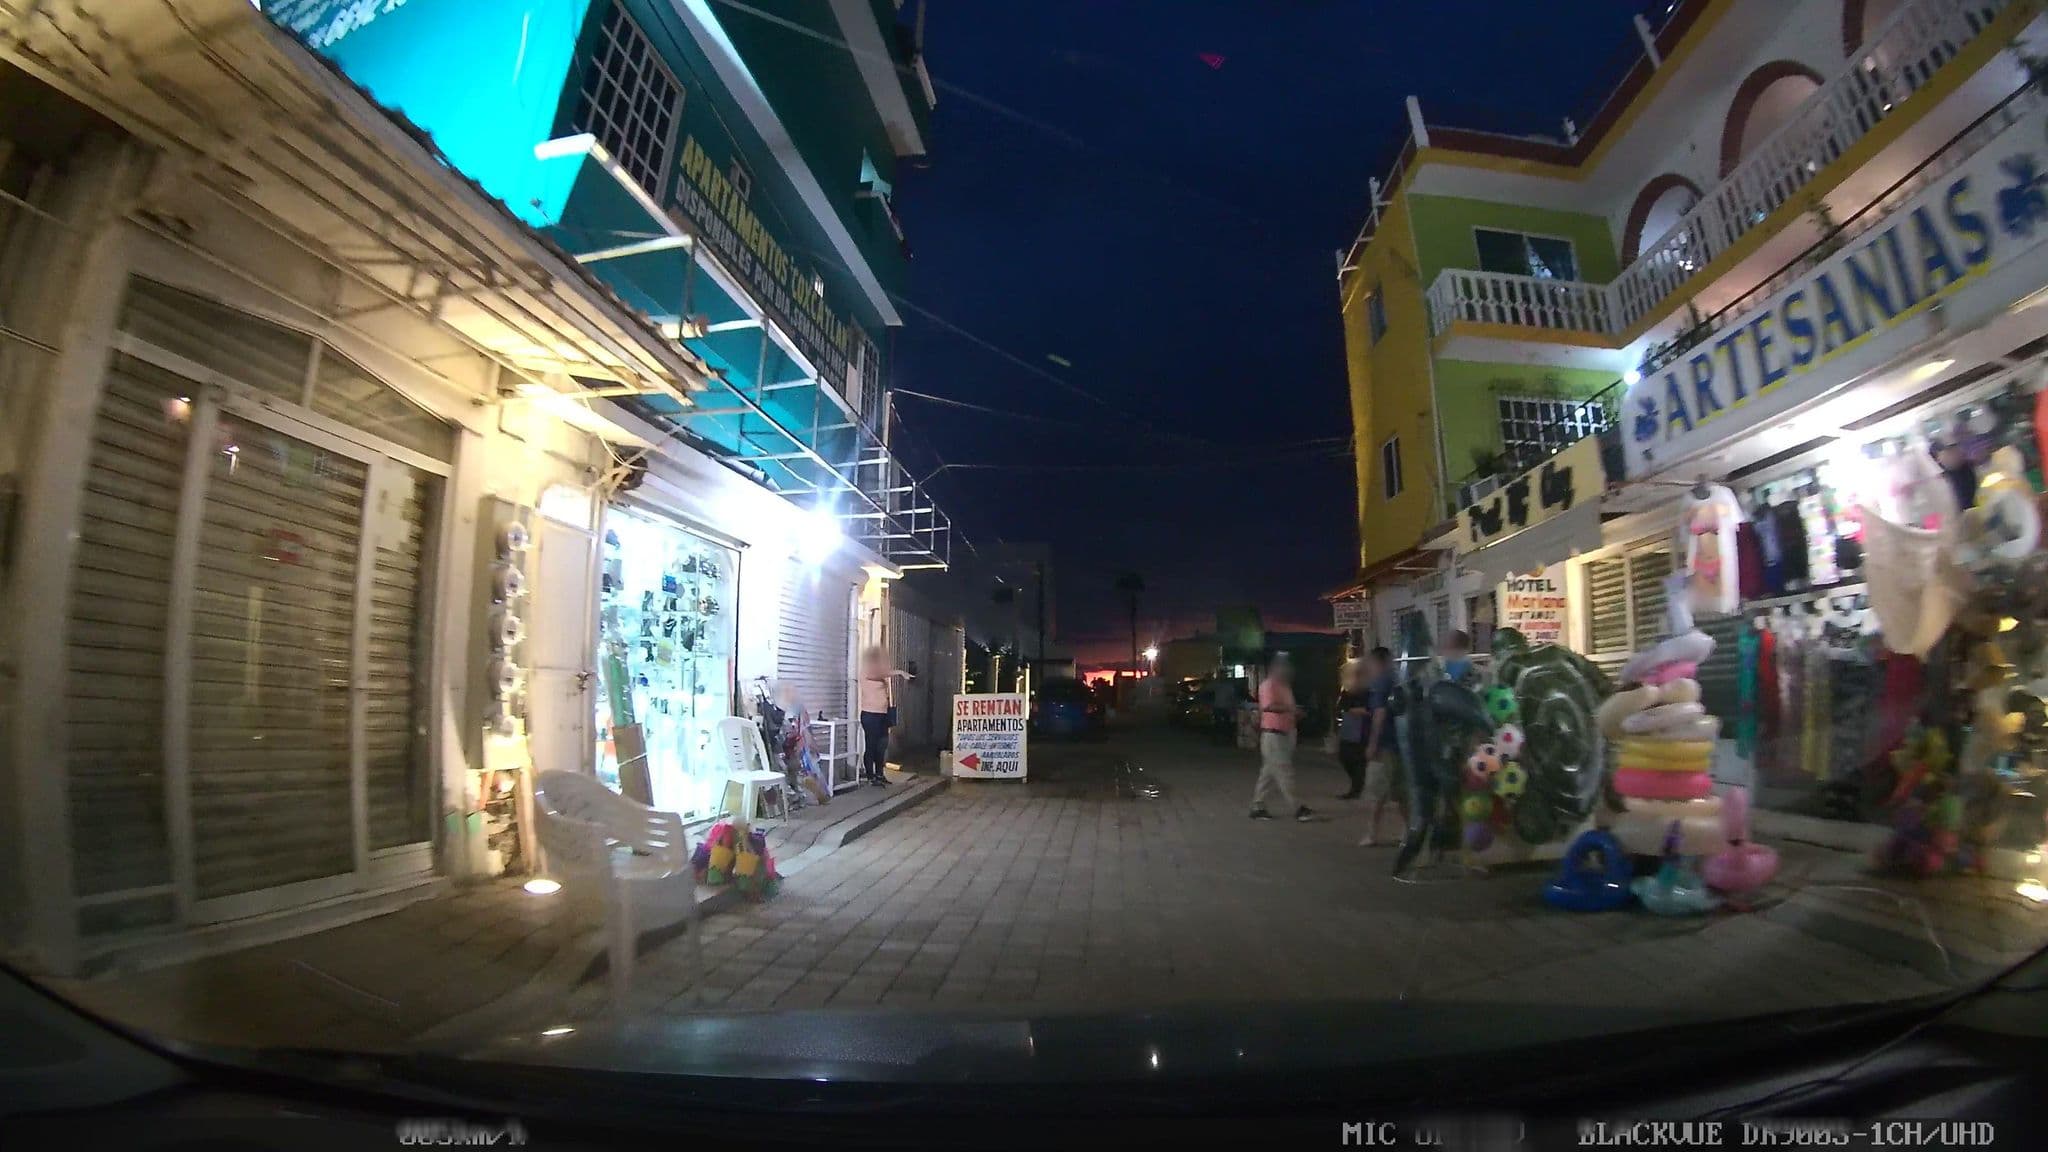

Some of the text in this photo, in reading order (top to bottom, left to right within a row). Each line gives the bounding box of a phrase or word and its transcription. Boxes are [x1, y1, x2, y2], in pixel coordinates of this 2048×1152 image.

[680, 134, 788, 285] APARTAMENTOS
[675, 173, 752, 277] DISPONIBLES
[753, 262, 776, 302] POR
[1664, 176, 1993, 440] ARTESANIAS
[1507, 579, 1557, 593] HOTEL
[956, 699, 1022, 717] SE RENTAN
[956, 718, 1024, 732] APARTAMENTOS
[996, 760, 1019, 773] AQUI
